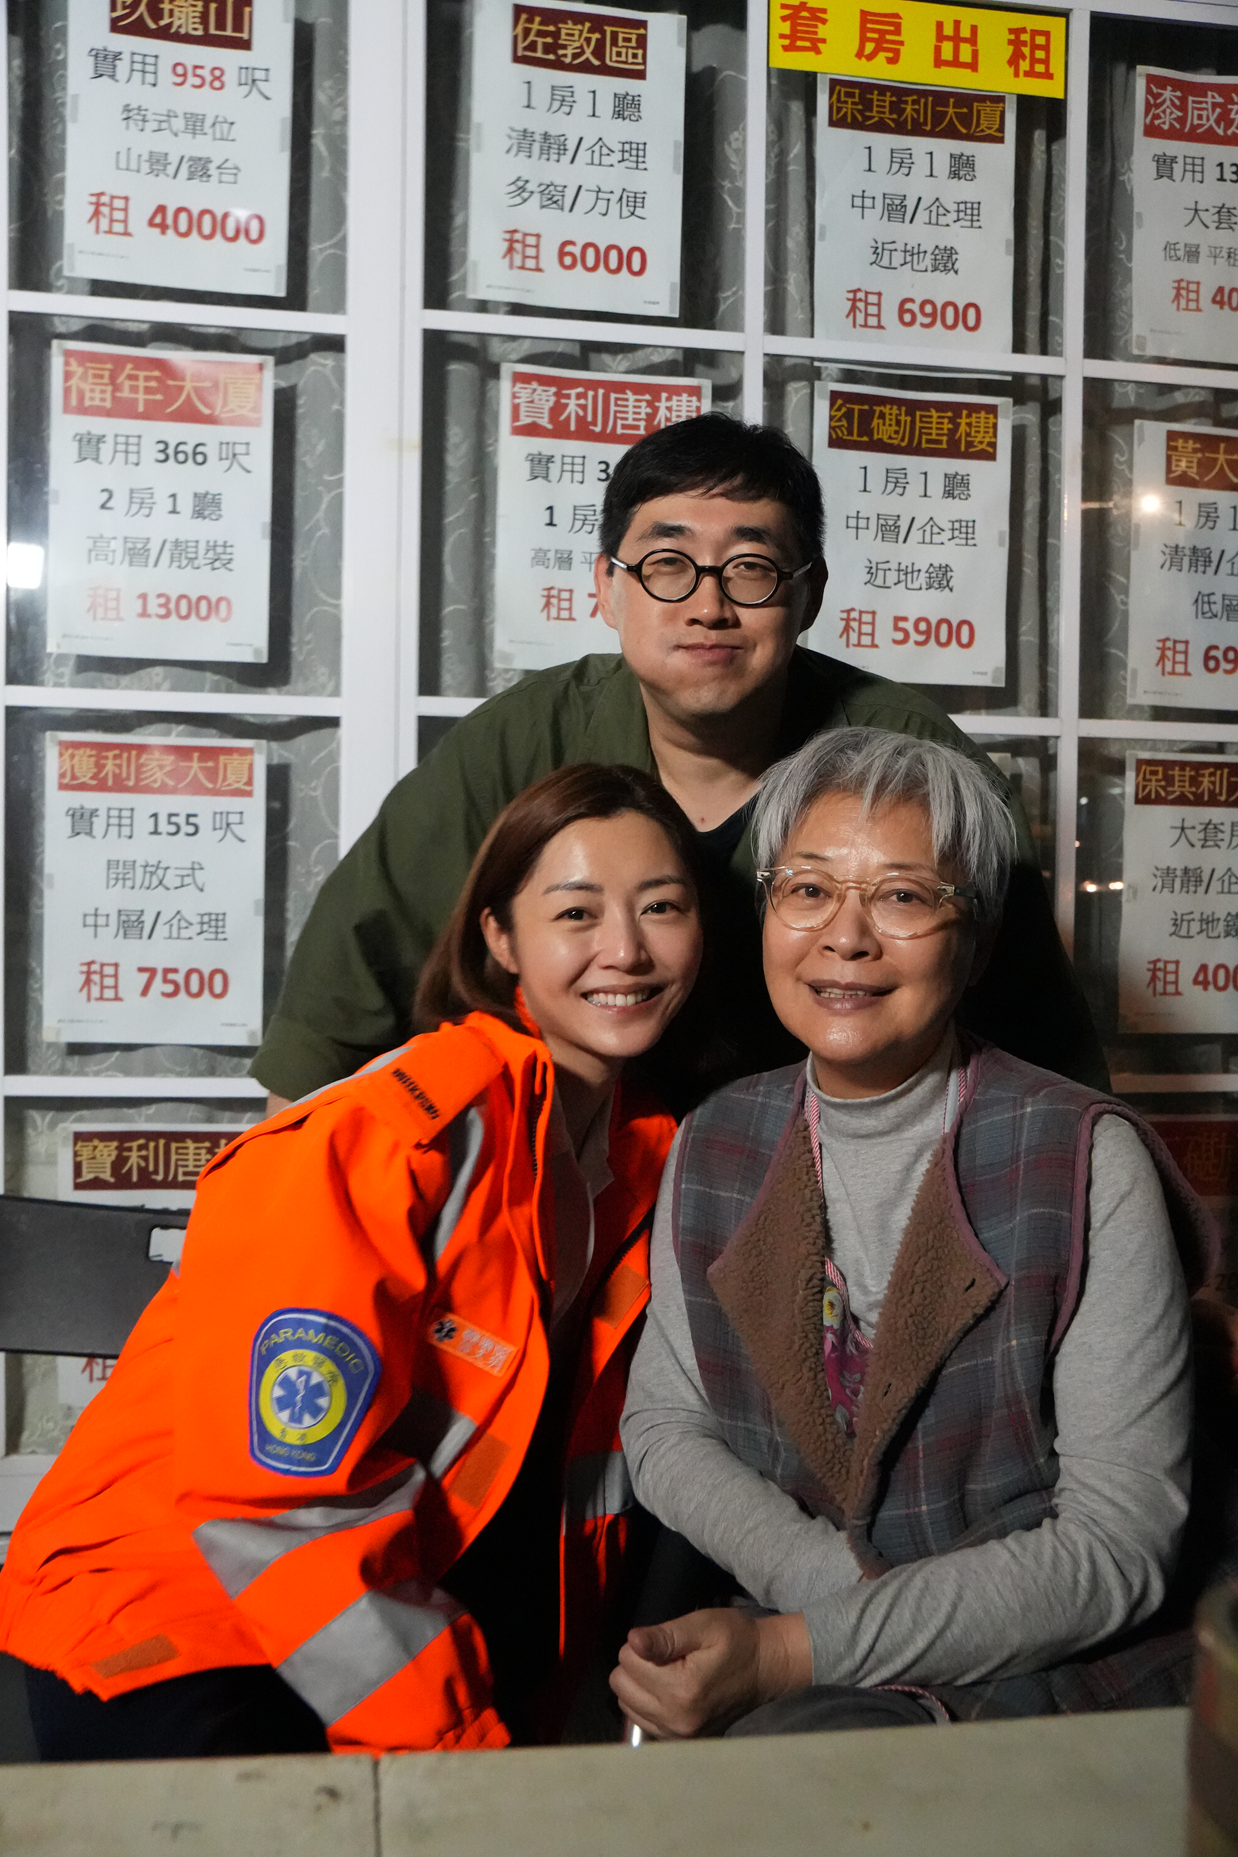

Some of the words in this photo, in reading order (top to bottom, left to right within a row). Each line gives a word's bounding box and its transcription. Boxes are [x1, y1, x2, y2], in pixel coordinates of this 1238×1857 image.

[513, 13, 645, 69] 佐敦區
[88, 47, 159, 87] 實用
[171, 62, 226, 91] 958
[238, 66, 272, 100] 呎
[121, 103, 236, 142] 特式單位
[829, 85, 1004, 137] 保其利大廈
[115, 147, 241, 184] 山景/露台
[505, 126, 648, 171] 清靜/企理
[1152, 152, 1205, 183] 實用
[87, 191, 133, 237] 租
[147, 204, 265, 245] 40000
[505, 176, 648, 220] 多窗/方便
[851, 189, 983, 229] 中層/企理
[1183, 200, 1238, 231] 大套
[502, 228, 545, 273] 租
[557, 239, 648, 277] 6000
[869, 238, 959, 275] 近地鐵
[845, 287, 886, 330] 租
[897, 297, 982, 332] 6900
[1171, 278, 1203, 313] 租
[64, 357, 262, 419] 福年大廈
[512, 381, 701, 436] 寶利唐樓
[829, 399, 997, 453] 紅磡唐樓
[72, 430, 142, 467] 實用
[154, 440, 208, 466] 366
[218, 441, 253, 474] 呎
[525, 452, 586, 484] 實用
[845, 510, 978, 547] 中層/企理
[86, 534, 235, 572] 高層/靚裝
[530, 548, 573, 571] 高層
[864, 558, 955, 593] 近地鐵
[86, 585, 124, 623] 租
[136, 592, 232, 623] 13000
[540, 586, 576, 622] 租
[1193, 591, 1238, 622] 低層
[839, 607, 879, 649] 租
[892, 615, 975, 649] 5900
[1156, 636, 1192, 677] 租
[1203, 645, 1238, 675] 69
[59, 748, 252, 791] 獲利家大廈
[1136, 764, 1238, 802] 保其利
[65, 804, 135, 839] 實用
[147, 812, 200, 837] 155
[211, 810, 247, 844] 呎
[105, 859, 205, 893] 開放式
[82, 907, 229, 942] 中層/企理
[78, 960, 124, 1003] 租
[137, 967, 230, 999] 7500
[1147, 957, 1183, 999] 租
[74, 1139, 230, 1184] 寶利唐
[260, 1328, 365, 1374] PARAMEDIC
